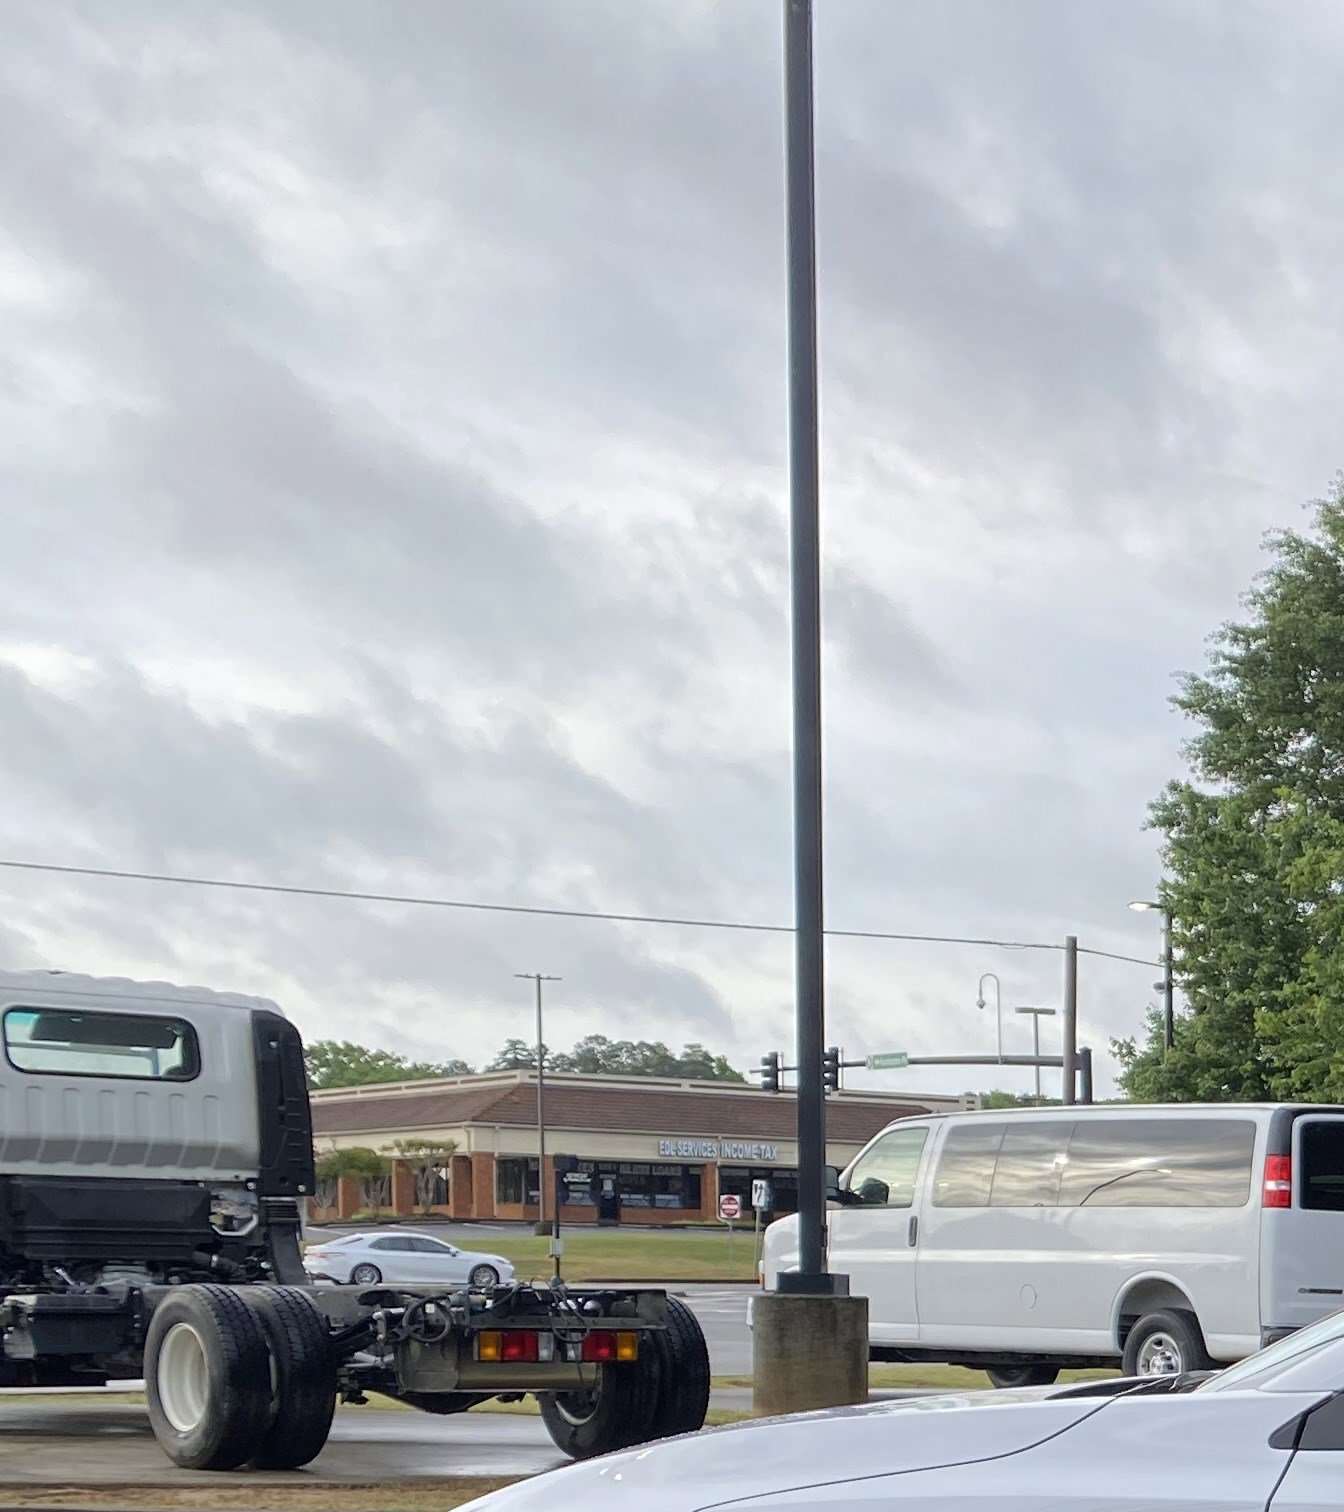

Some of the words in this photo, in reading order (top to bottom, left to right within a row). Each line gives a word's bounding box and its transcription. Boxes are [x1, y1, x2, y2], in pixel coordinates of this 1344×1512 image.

[677, 1140, 717, 1158] SERVICES
[721, 1142, 758, 1159] INCOME
[760, 1144, 778, 1160] TAX
